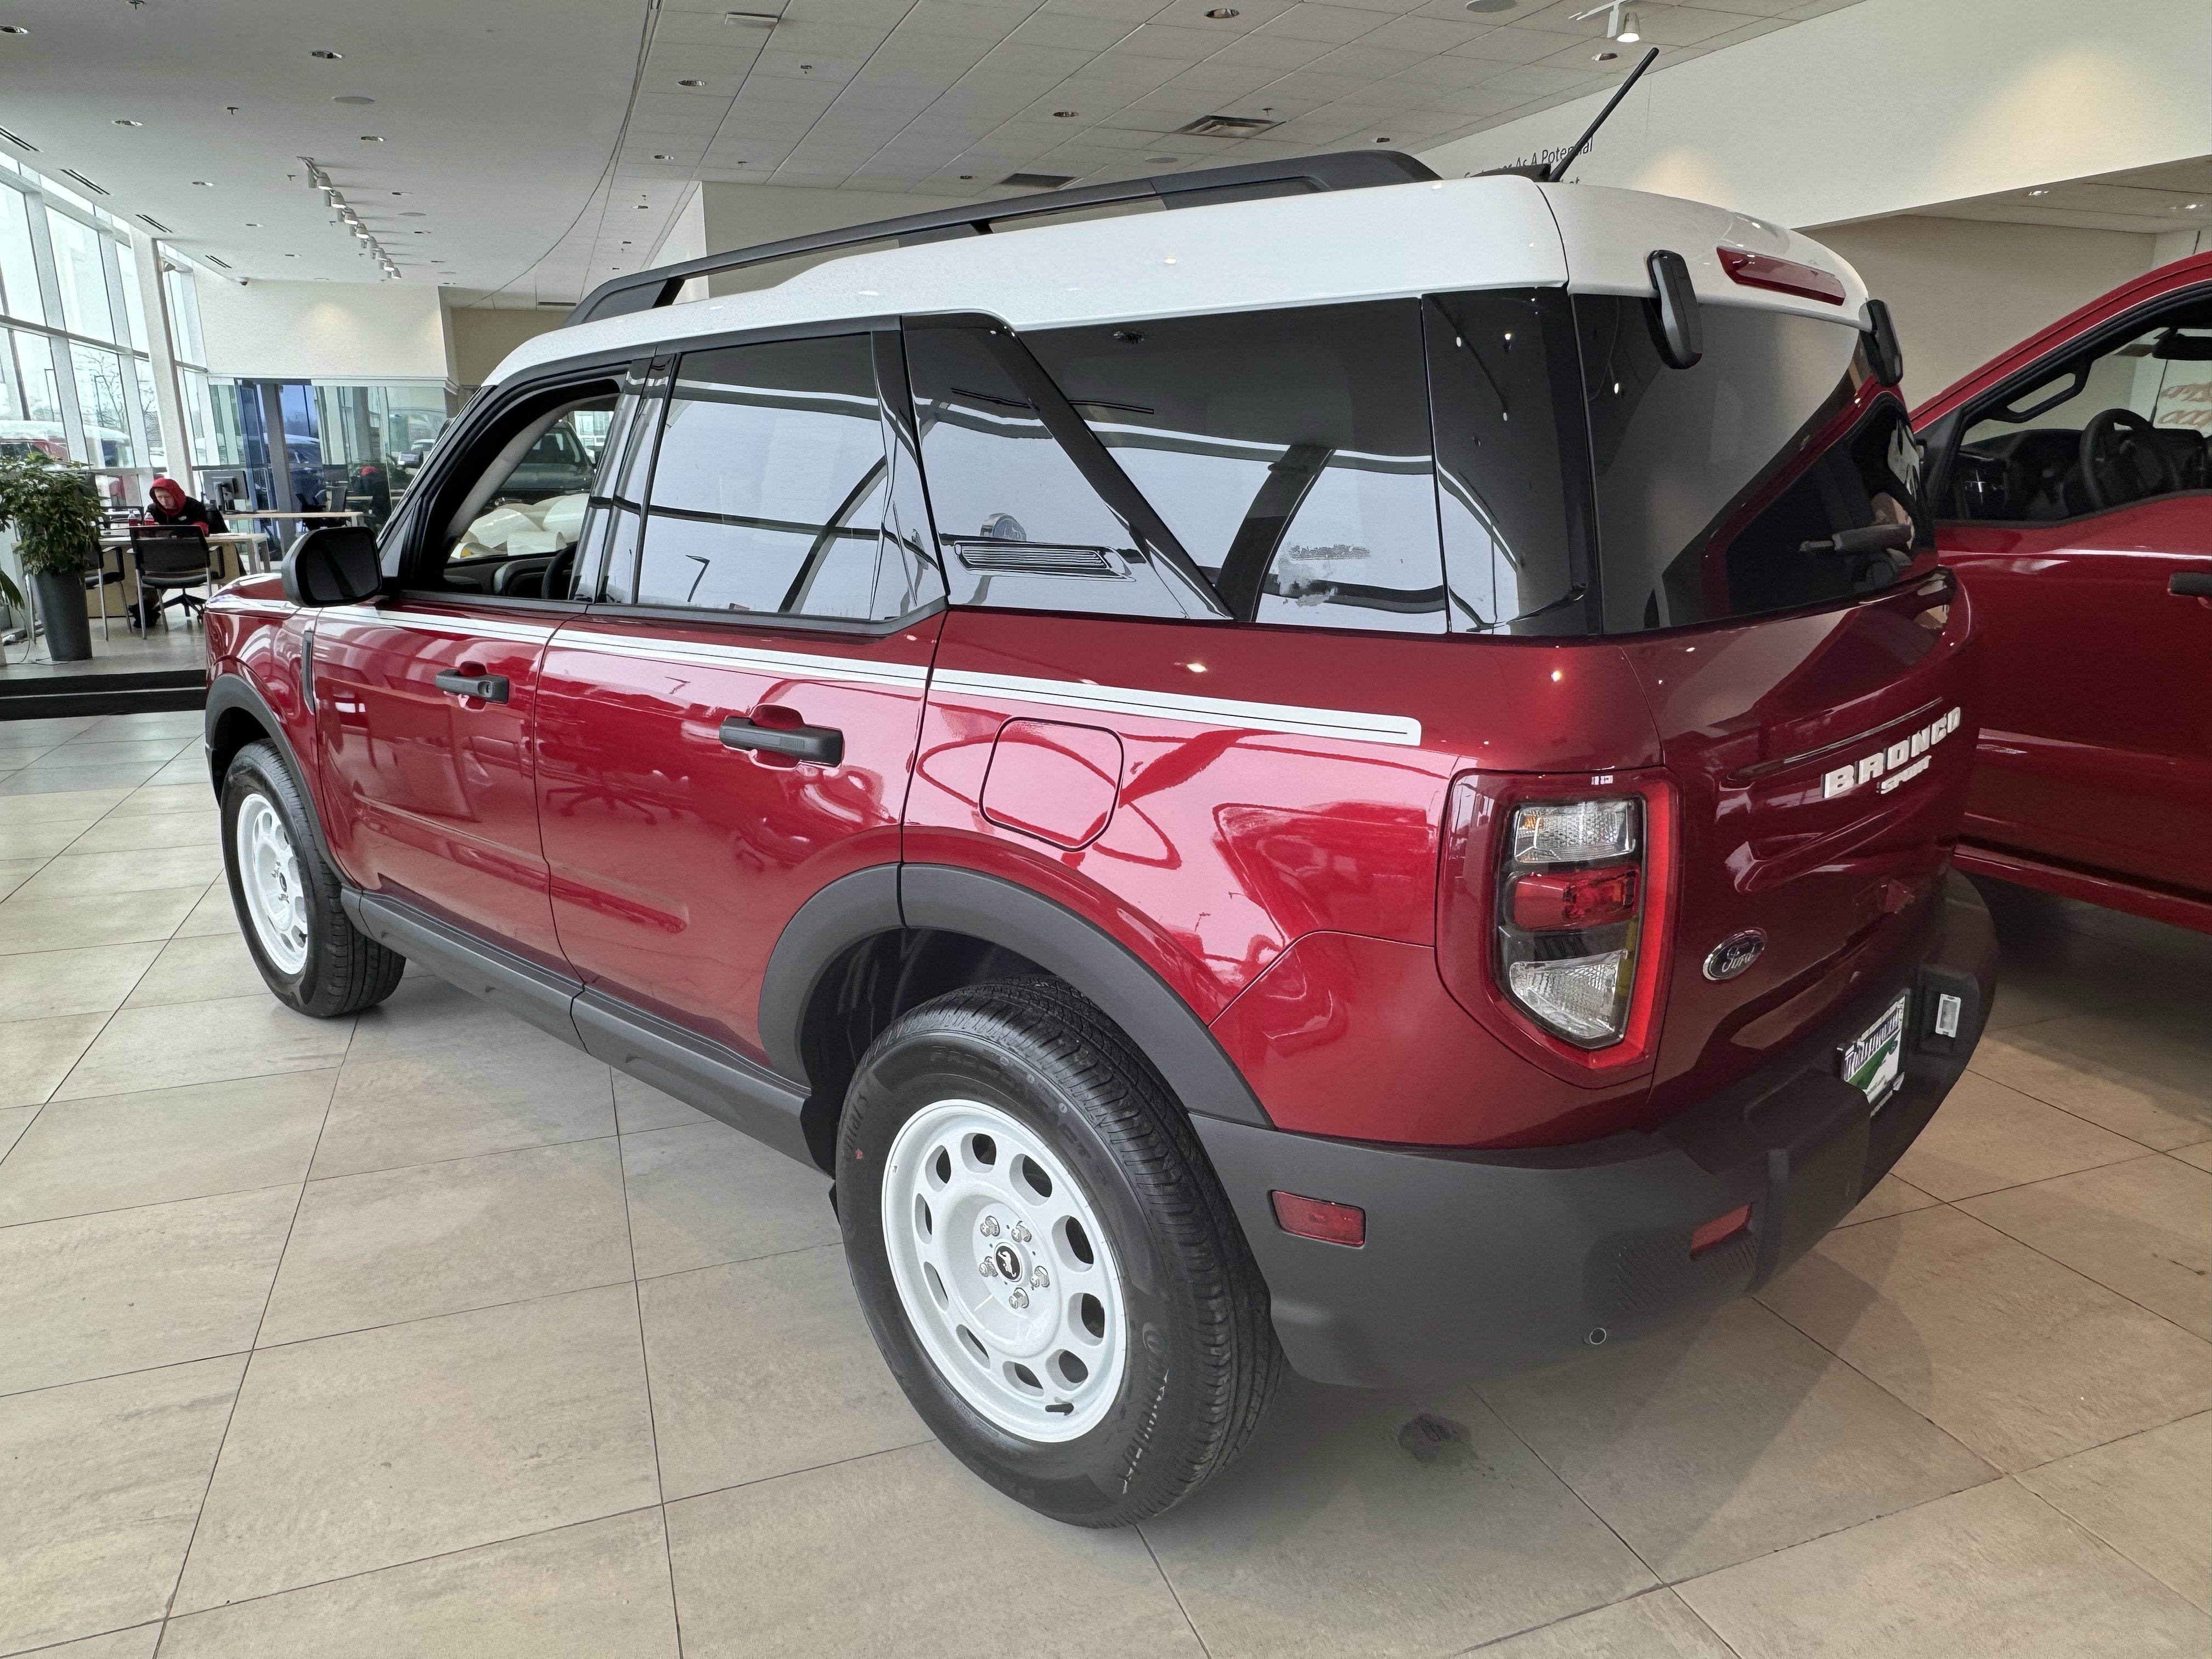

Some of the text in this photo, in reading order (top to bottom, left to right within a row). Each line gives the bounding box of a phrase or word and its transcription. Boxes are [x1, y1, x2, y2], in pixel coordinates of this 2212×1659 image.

[1531, 153, 1537, 165] A
[1542, 137, 1593, 163] Potenal
[1821, 707, 1961, 798] BRONCO
